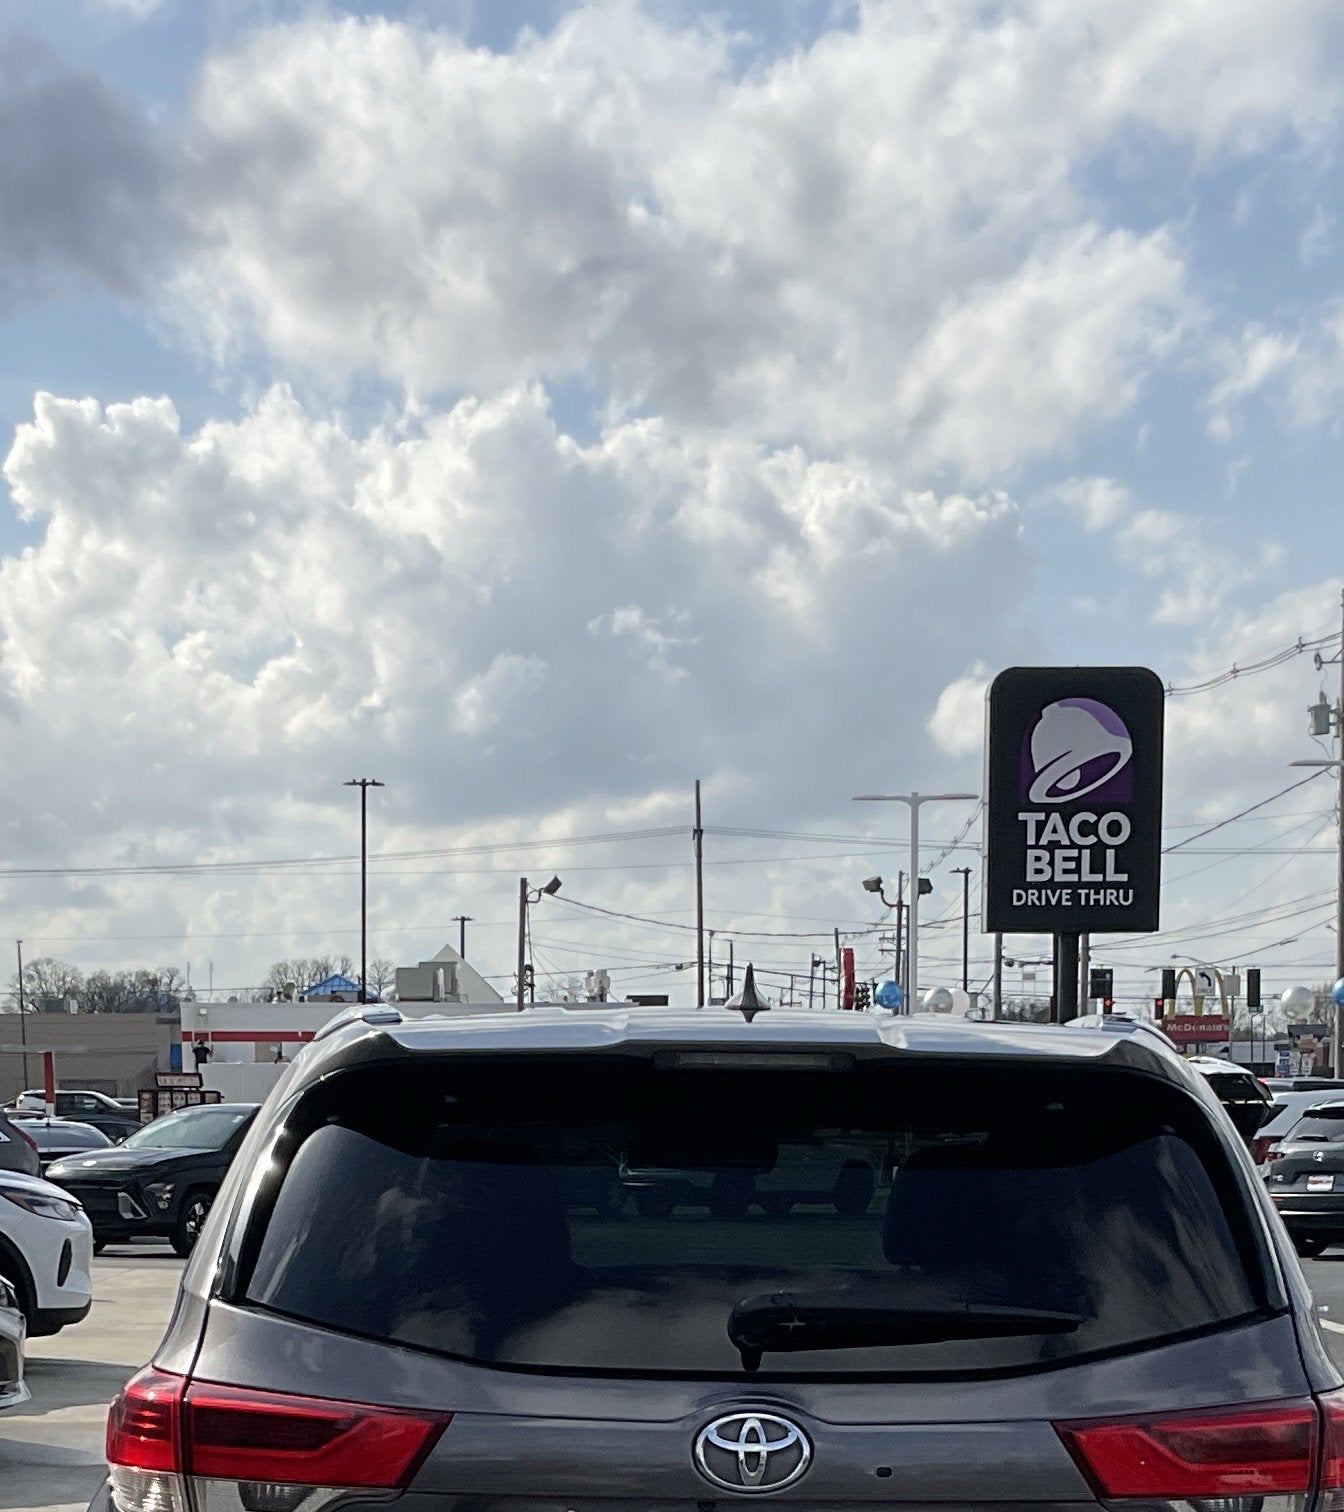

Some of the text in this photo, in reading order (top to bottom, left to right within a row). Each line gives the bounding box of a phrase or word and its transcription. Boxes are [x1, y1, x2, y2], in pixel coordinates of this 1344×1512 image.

[1017, 811, 1132, 846] TACO
[1025, 849, 1129, 882] BELL
[1012, 889, 1134, 906] DRIVE THRU
